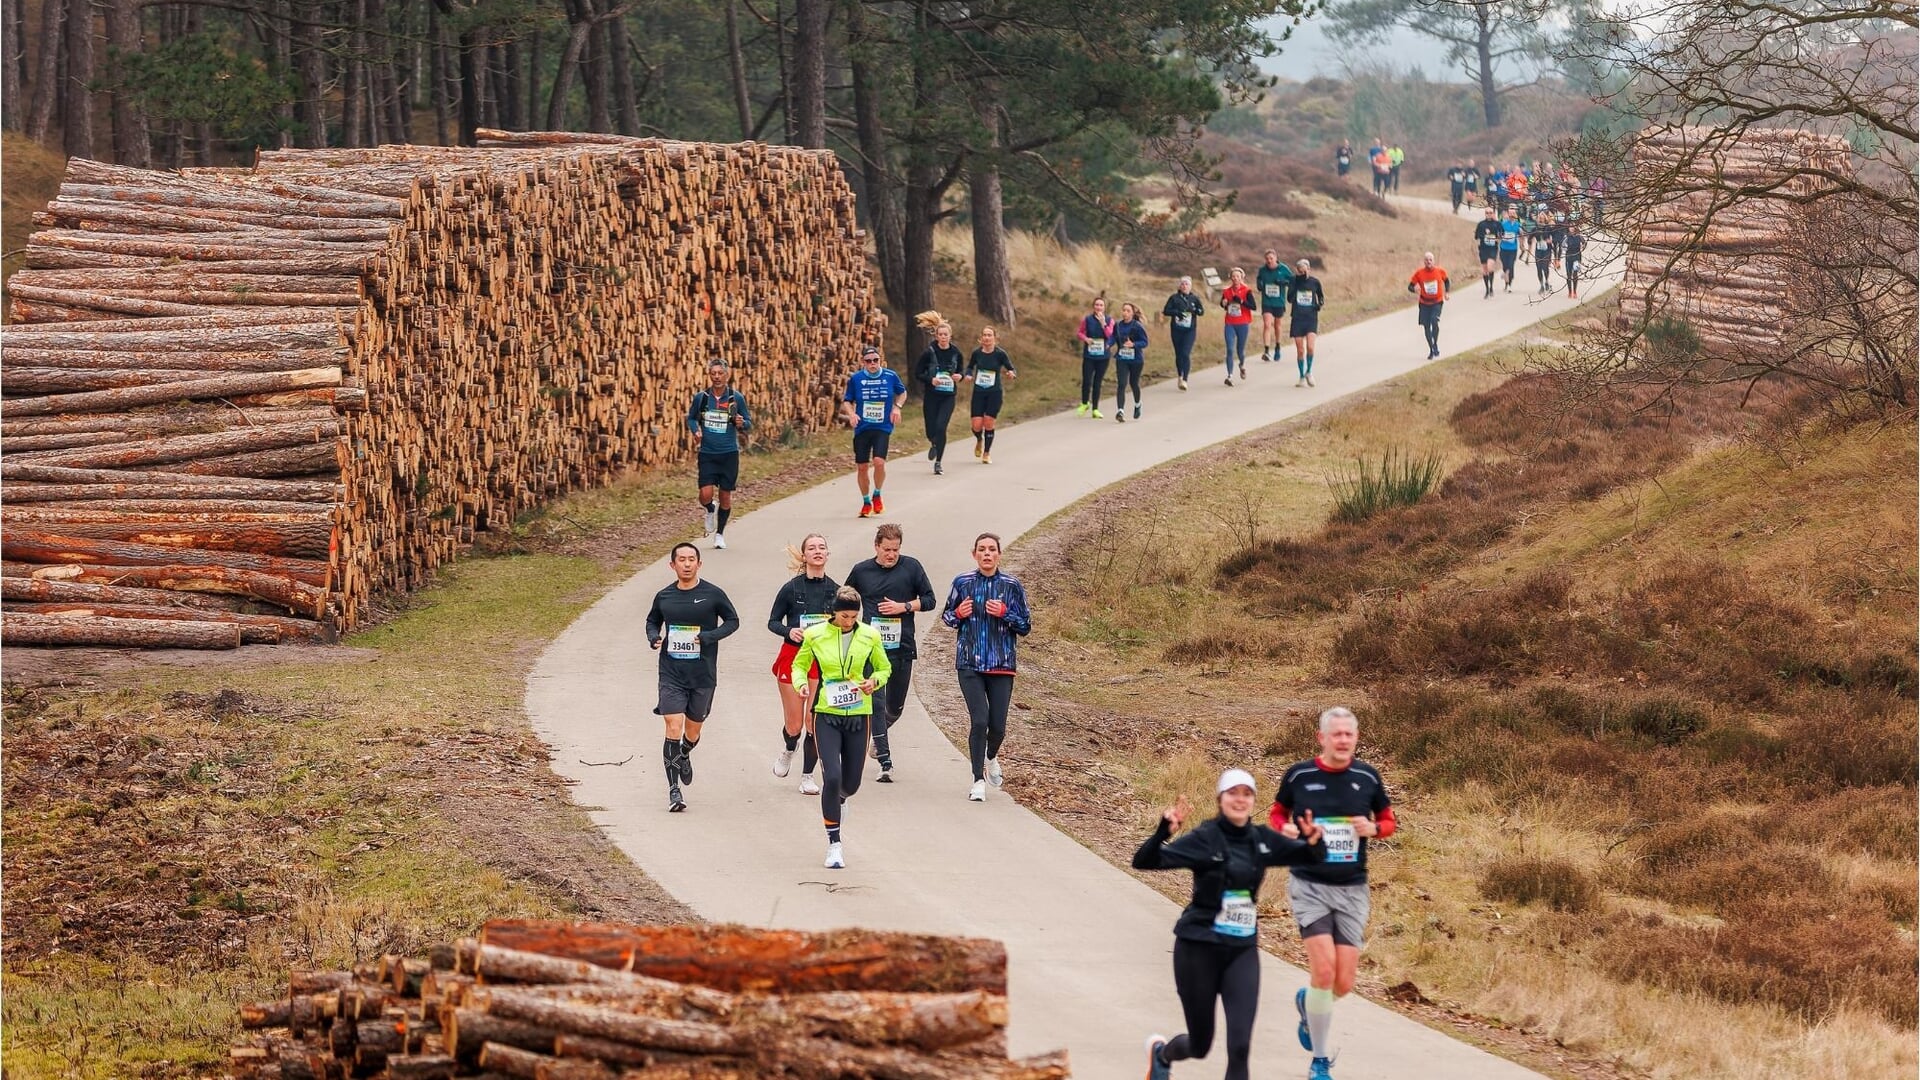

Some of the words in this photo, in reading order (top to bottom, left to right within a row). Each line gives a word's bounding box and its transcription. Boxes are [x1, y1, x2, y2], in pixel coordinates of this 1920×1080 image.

[672, 641, 695, 651] 33461
[838, 684, 849, 692] EVA
[832, 692, 857, 704] 32837
[1327, 840, 1354, 851] 4809
